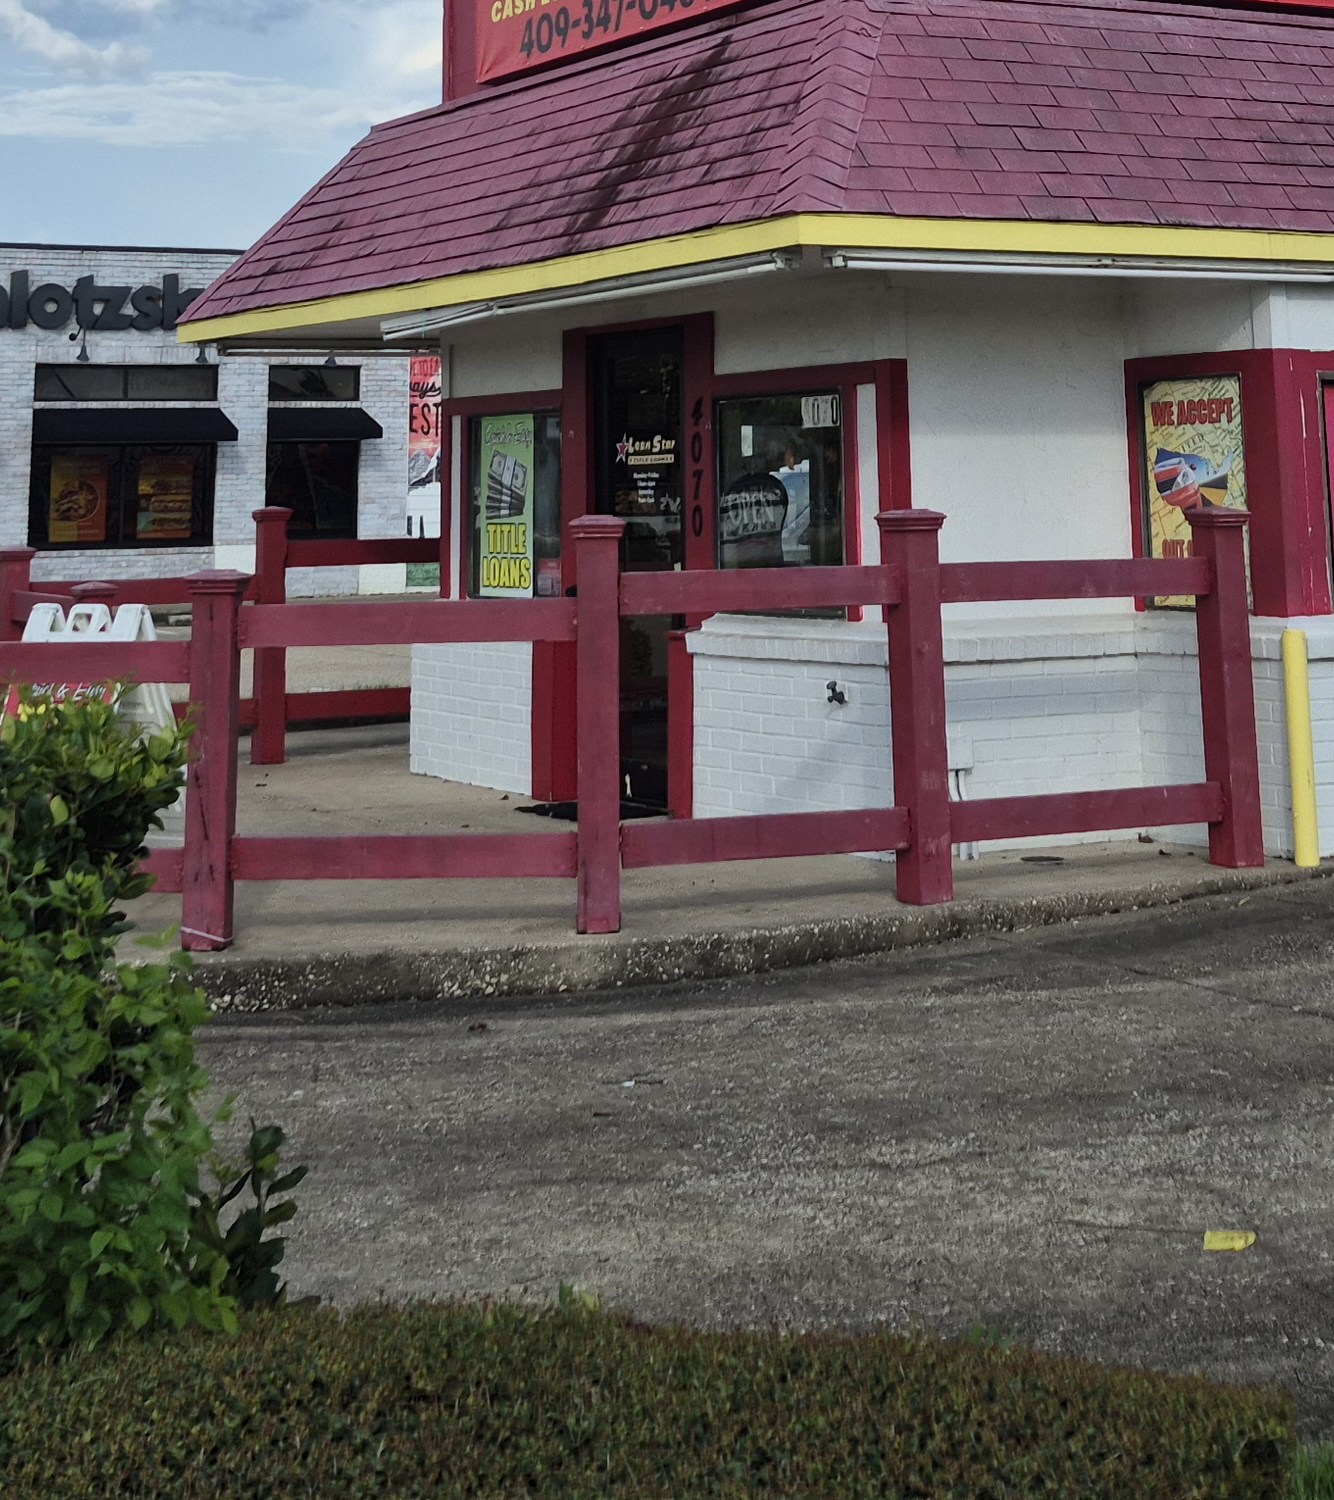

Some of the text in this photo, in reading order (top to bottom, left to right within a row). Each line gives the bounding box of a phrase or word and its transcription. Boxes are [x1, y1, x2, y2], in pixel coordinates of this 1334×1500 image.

[1151, 397, 1234, 427] WE ACCEPT
[628, 434, 676, 454] Loan Star
[691, 396, 703, 537] 4070
[486, 523, 527, 555] TITLE
[482, 556, 532, 590] LOANS
